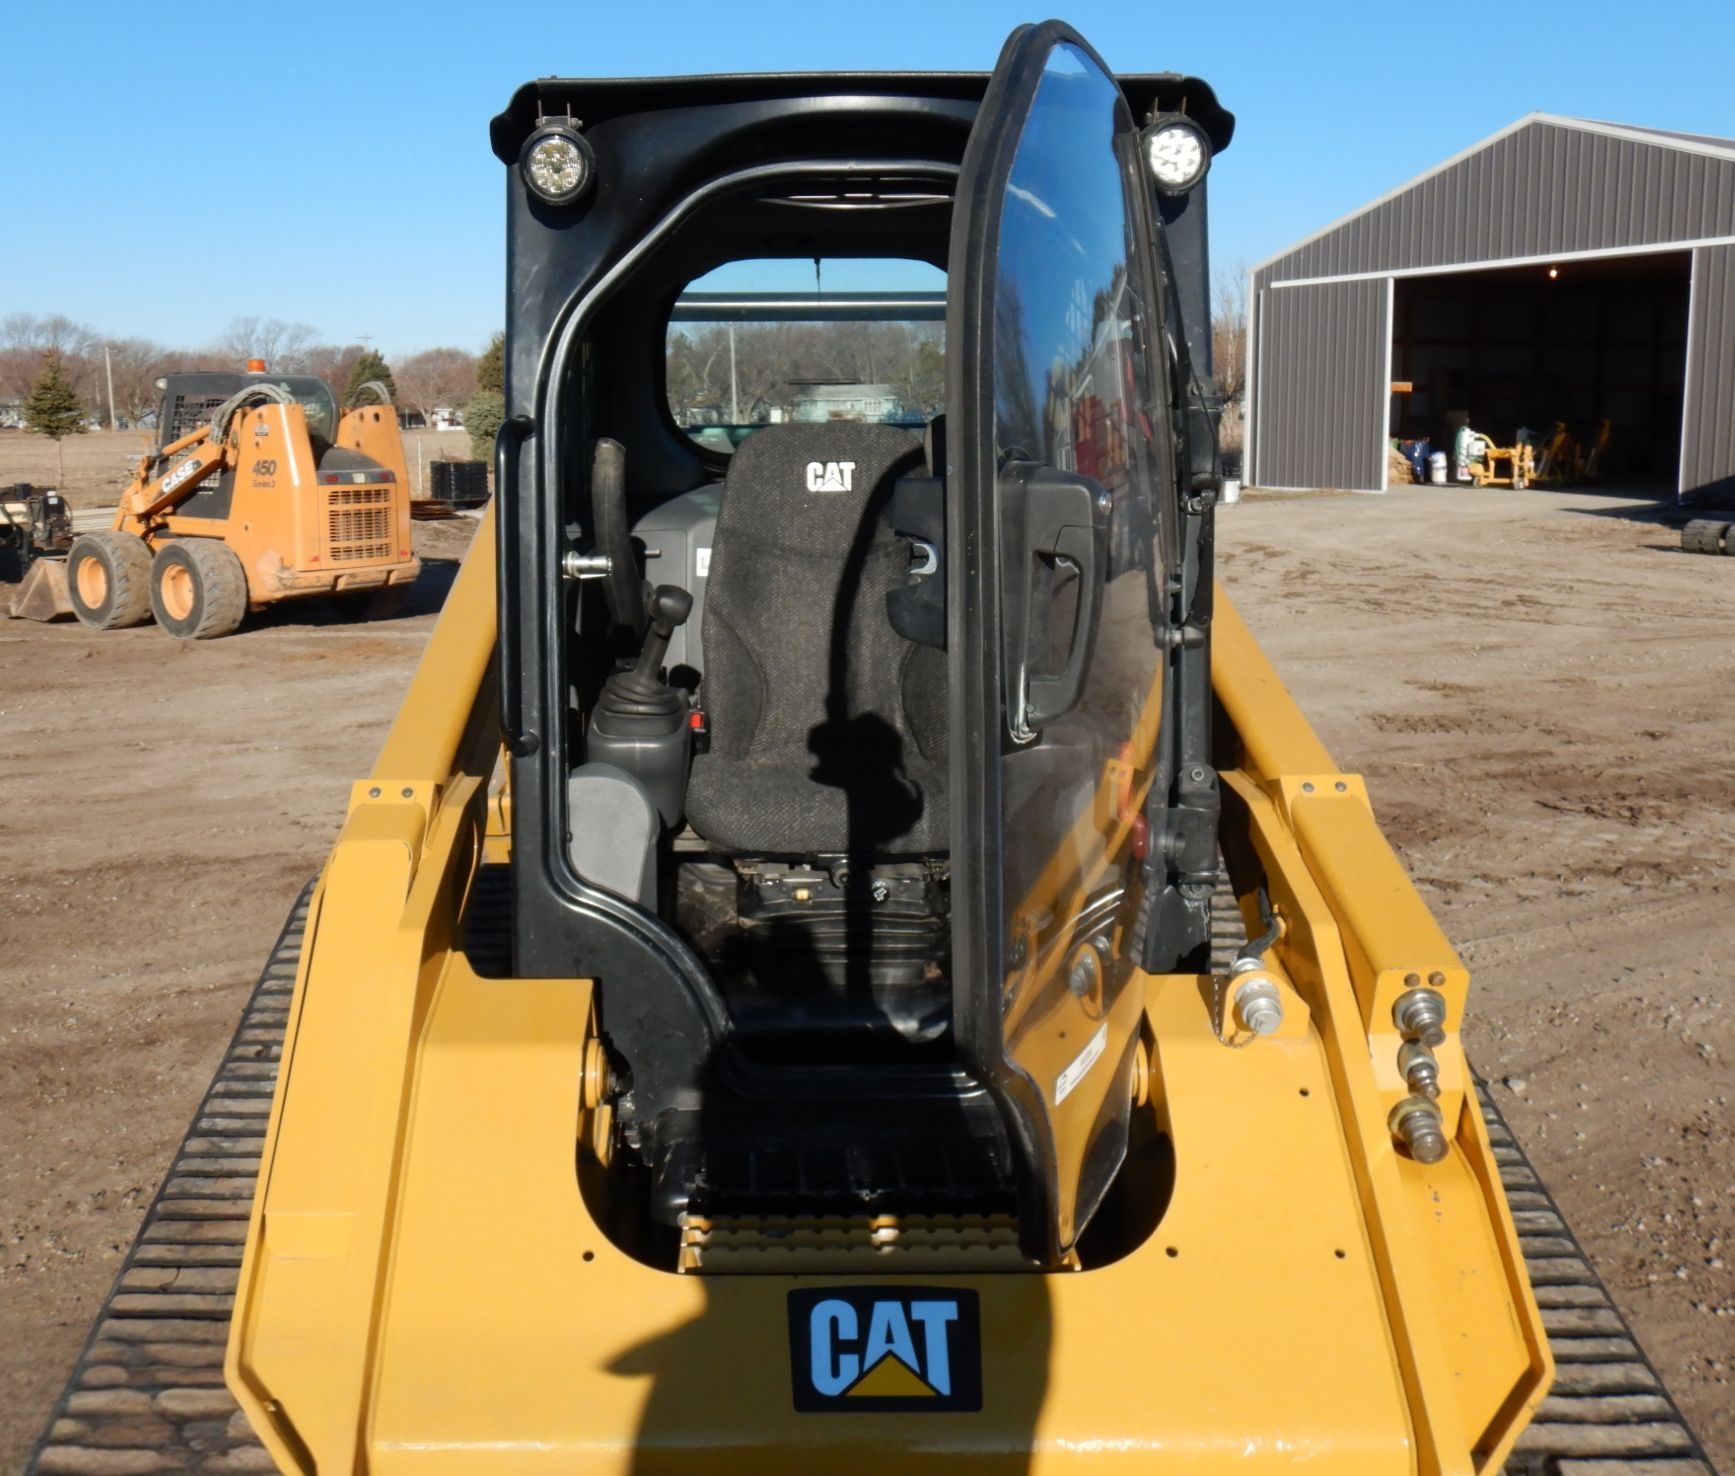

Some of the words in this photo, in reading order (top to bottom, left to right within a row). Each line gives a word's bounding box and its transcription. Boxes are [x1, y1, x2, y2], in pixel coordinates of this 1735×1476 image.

[161, 460, 197, 492] CASE
[252, 459, 276, 476] 450
[806, 461, 856, 492] CAT
[810, 1299, 958, 1397] CAT
